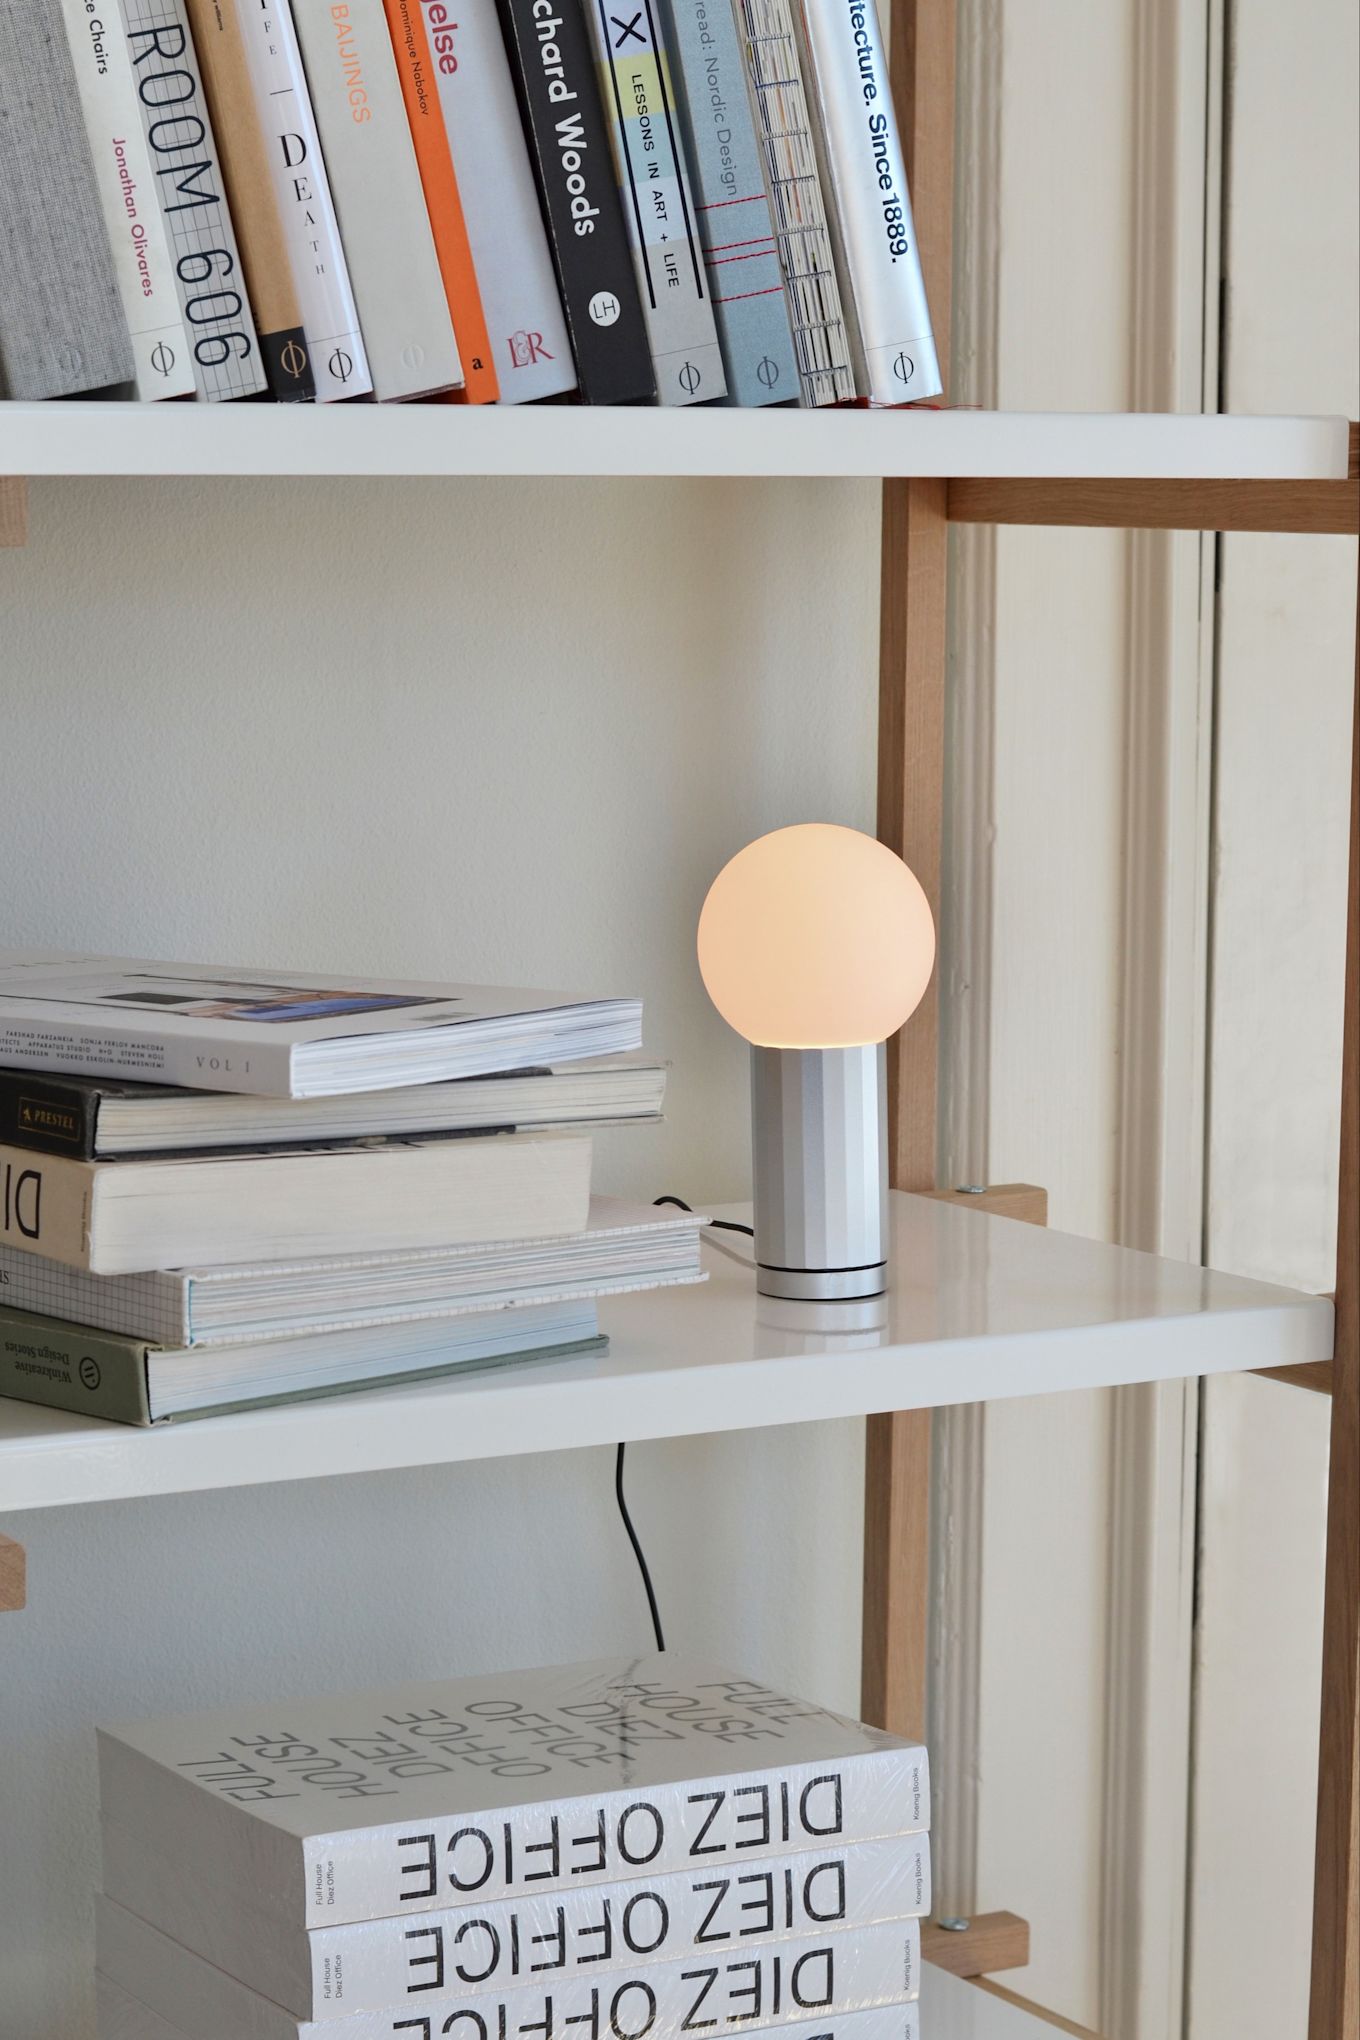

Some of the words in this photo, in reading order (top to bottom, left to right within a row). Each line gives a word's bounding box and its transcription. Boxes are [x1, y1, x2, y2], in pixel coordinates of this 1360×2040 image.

[89, 19, 108, 75] Chairs
[421, 0, 458, 75] else
[532, 0, 578, 103] chard
[610, 12, 647, 48] X
[331, 4, 372, 124] BAIJINGS
[399, 0, 417, 59] ominique
[411, 60, 429, 116] Nabokov
[631, 74, 655, 152] LESSONS
[704, 57, 727, 123] Nordic
[717, 129, 738, 196] Design
[554, 112, 600, 237] Woods
[647, 162, 660, 179] IN
[868, 113, 893, 191] Since
[882, 192, 908, 264] 1889.
[112, 137, 137, 218] Jonathan
[130, 224, 154, 297] Olivares
[127, 23, 221, 213] ROOM
[176, 248, 251, 367] 606
[277, 132, 326, 275] DEATH
[652, 190, 668, 222] ART
[659, 233, 668, 243] +
[663, 253, 680, 288] LIFE
[592, 299, 617, 319] LH
[472, 357, 484, 370] a
[196, 1056, 233, 1072] VOL
[34, 1110, 74, 1130] PRESTEL
[5, 1164, 42, 1239] DI
[5, 1342, 37, 1359] Stories
[36, 1346, 71, 1366] Design
[557, 1701, 687, 1746] DIEZ
[607, 1682, 785, 1744] HOUSE
[696, 1681, 825, 1725] FULL
[328, 1731, 455, 1779] DIEZ
[381, 1708, 553, 1778] OFFICE
[464, 1700, 637, 1768] OFFICE
[177, 1752, 301, 1802] FULL
[229, 1732, 400, 1799] HOUSE
[687, 1774, 843, 1857] DIEZ
[913, 1794, 921, 1821] Koenig
[326, 1860, 335, 1885] Office
[396, 1802, 664, 1901] OFFICE
[315, 1863, 323, 1889] House
[315, 1890, 323, 1905] Full
[327, 1888, 335, 1905] Diez
[915, 1878, 923, 1905] Koenig
[693, 1860, 847, 1945] DIEZ
[404, 1891, 670, 1993] OFFICE
[903, 1939, 911, 1964] Books
[323, 1957, 331, 1983] House
[335, 1954, 343, 1980] Office
[335, 1981, 343, 1998] Diez
[680, 1947, 834, 2032] DIEZ
[903, 1964, 911, 1991] Koenig
[323, 1984, 331, 1999] Full
